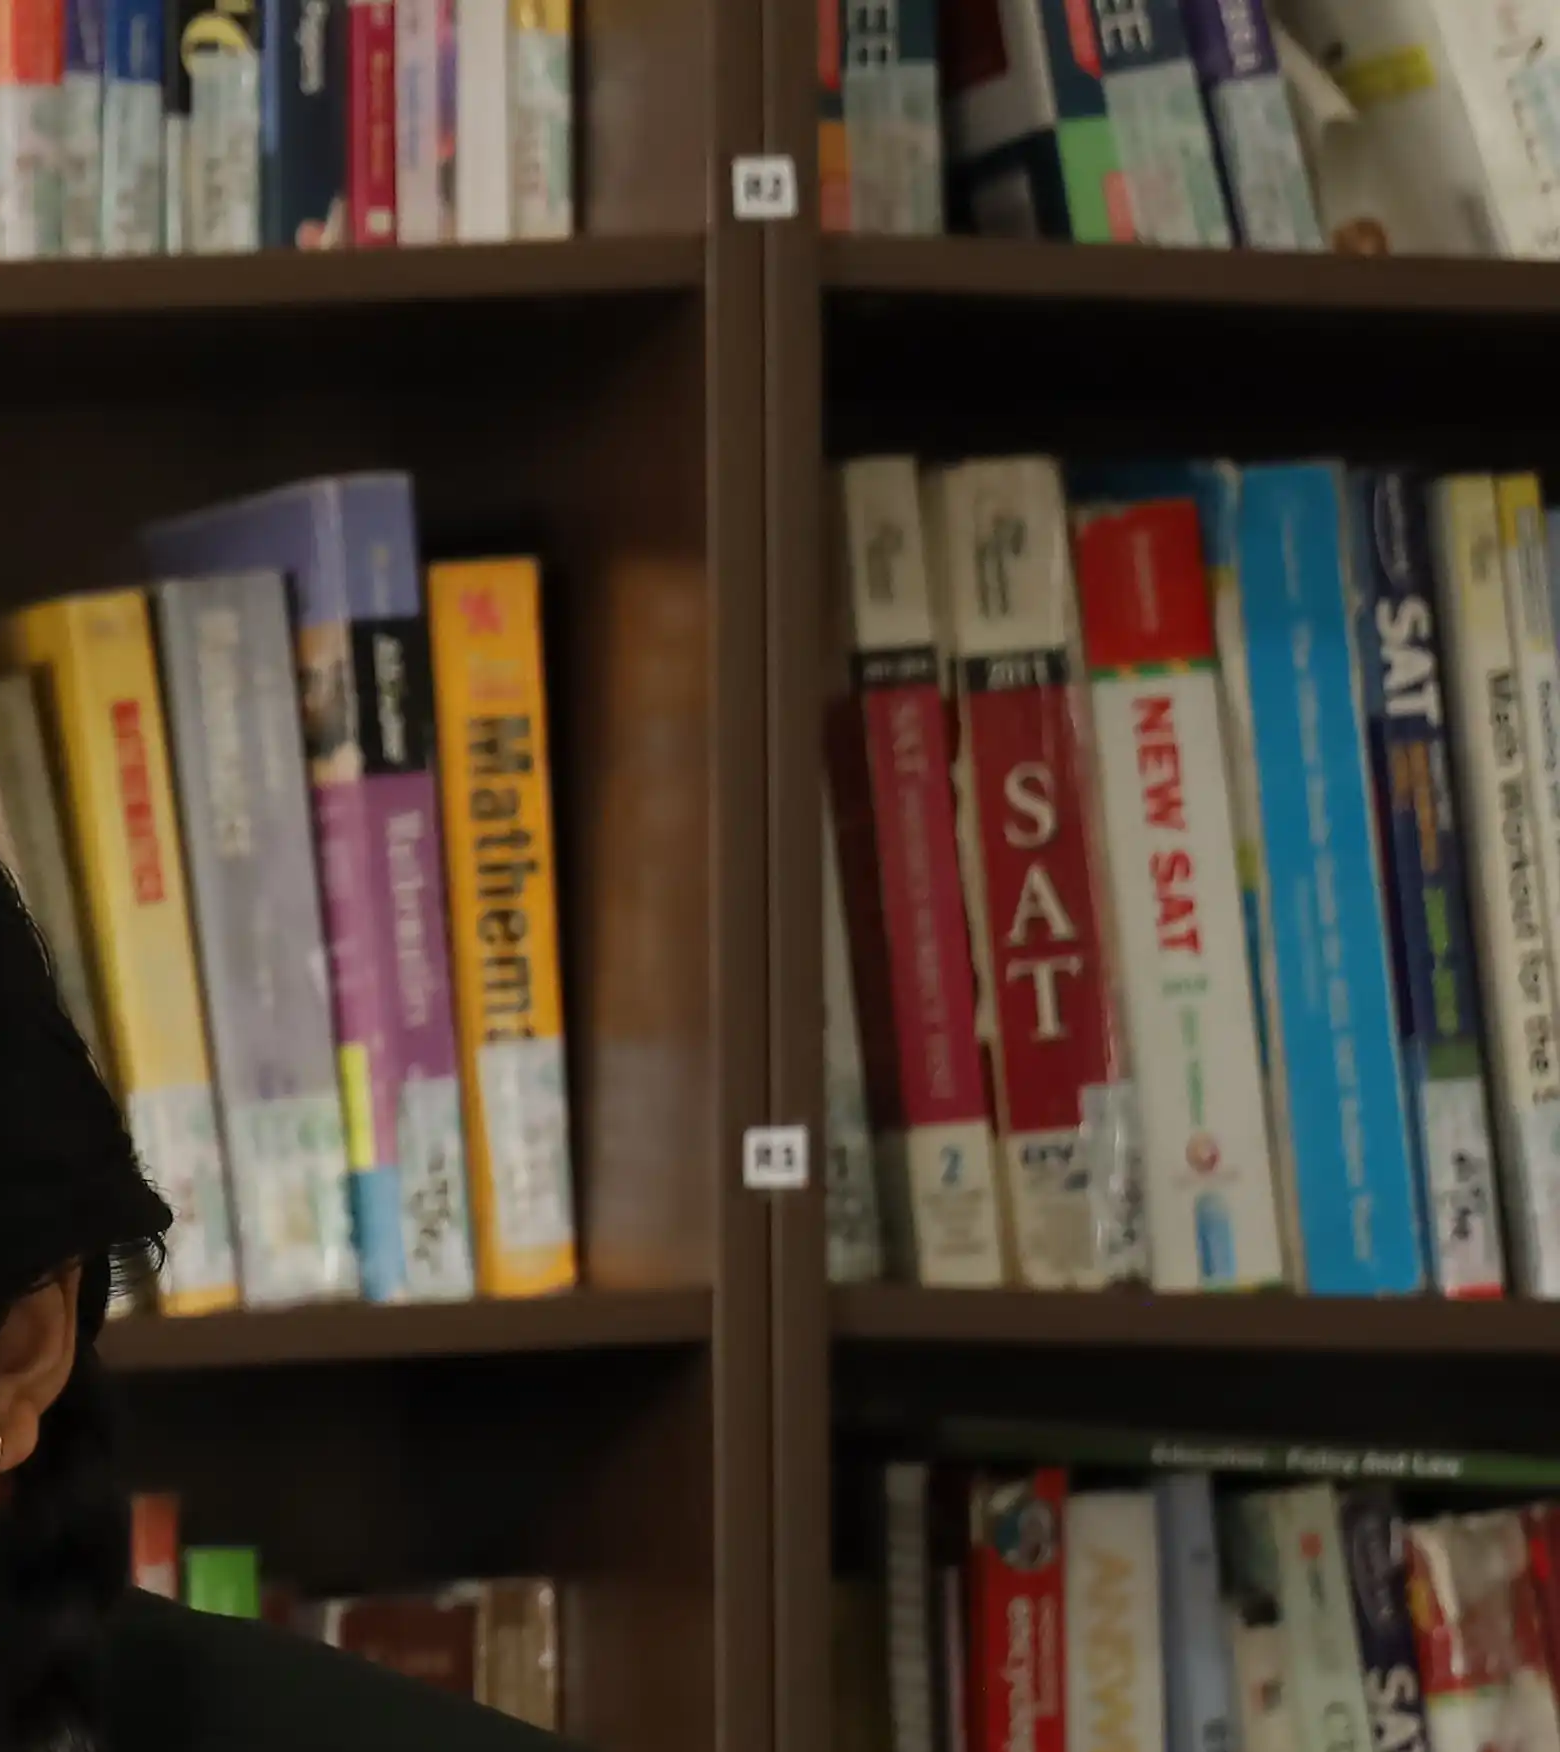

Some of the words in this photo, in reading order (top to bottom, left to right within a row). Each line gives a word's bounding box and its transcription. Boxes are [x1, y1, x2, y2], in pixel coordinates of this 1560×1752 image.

[1375, 594, 1436, 727] SAT
[1131, 694, 1182, 831] NEW
[1000, 763, 1082, 1044] SAT
[1148, 849, 1201, 957] SAT
